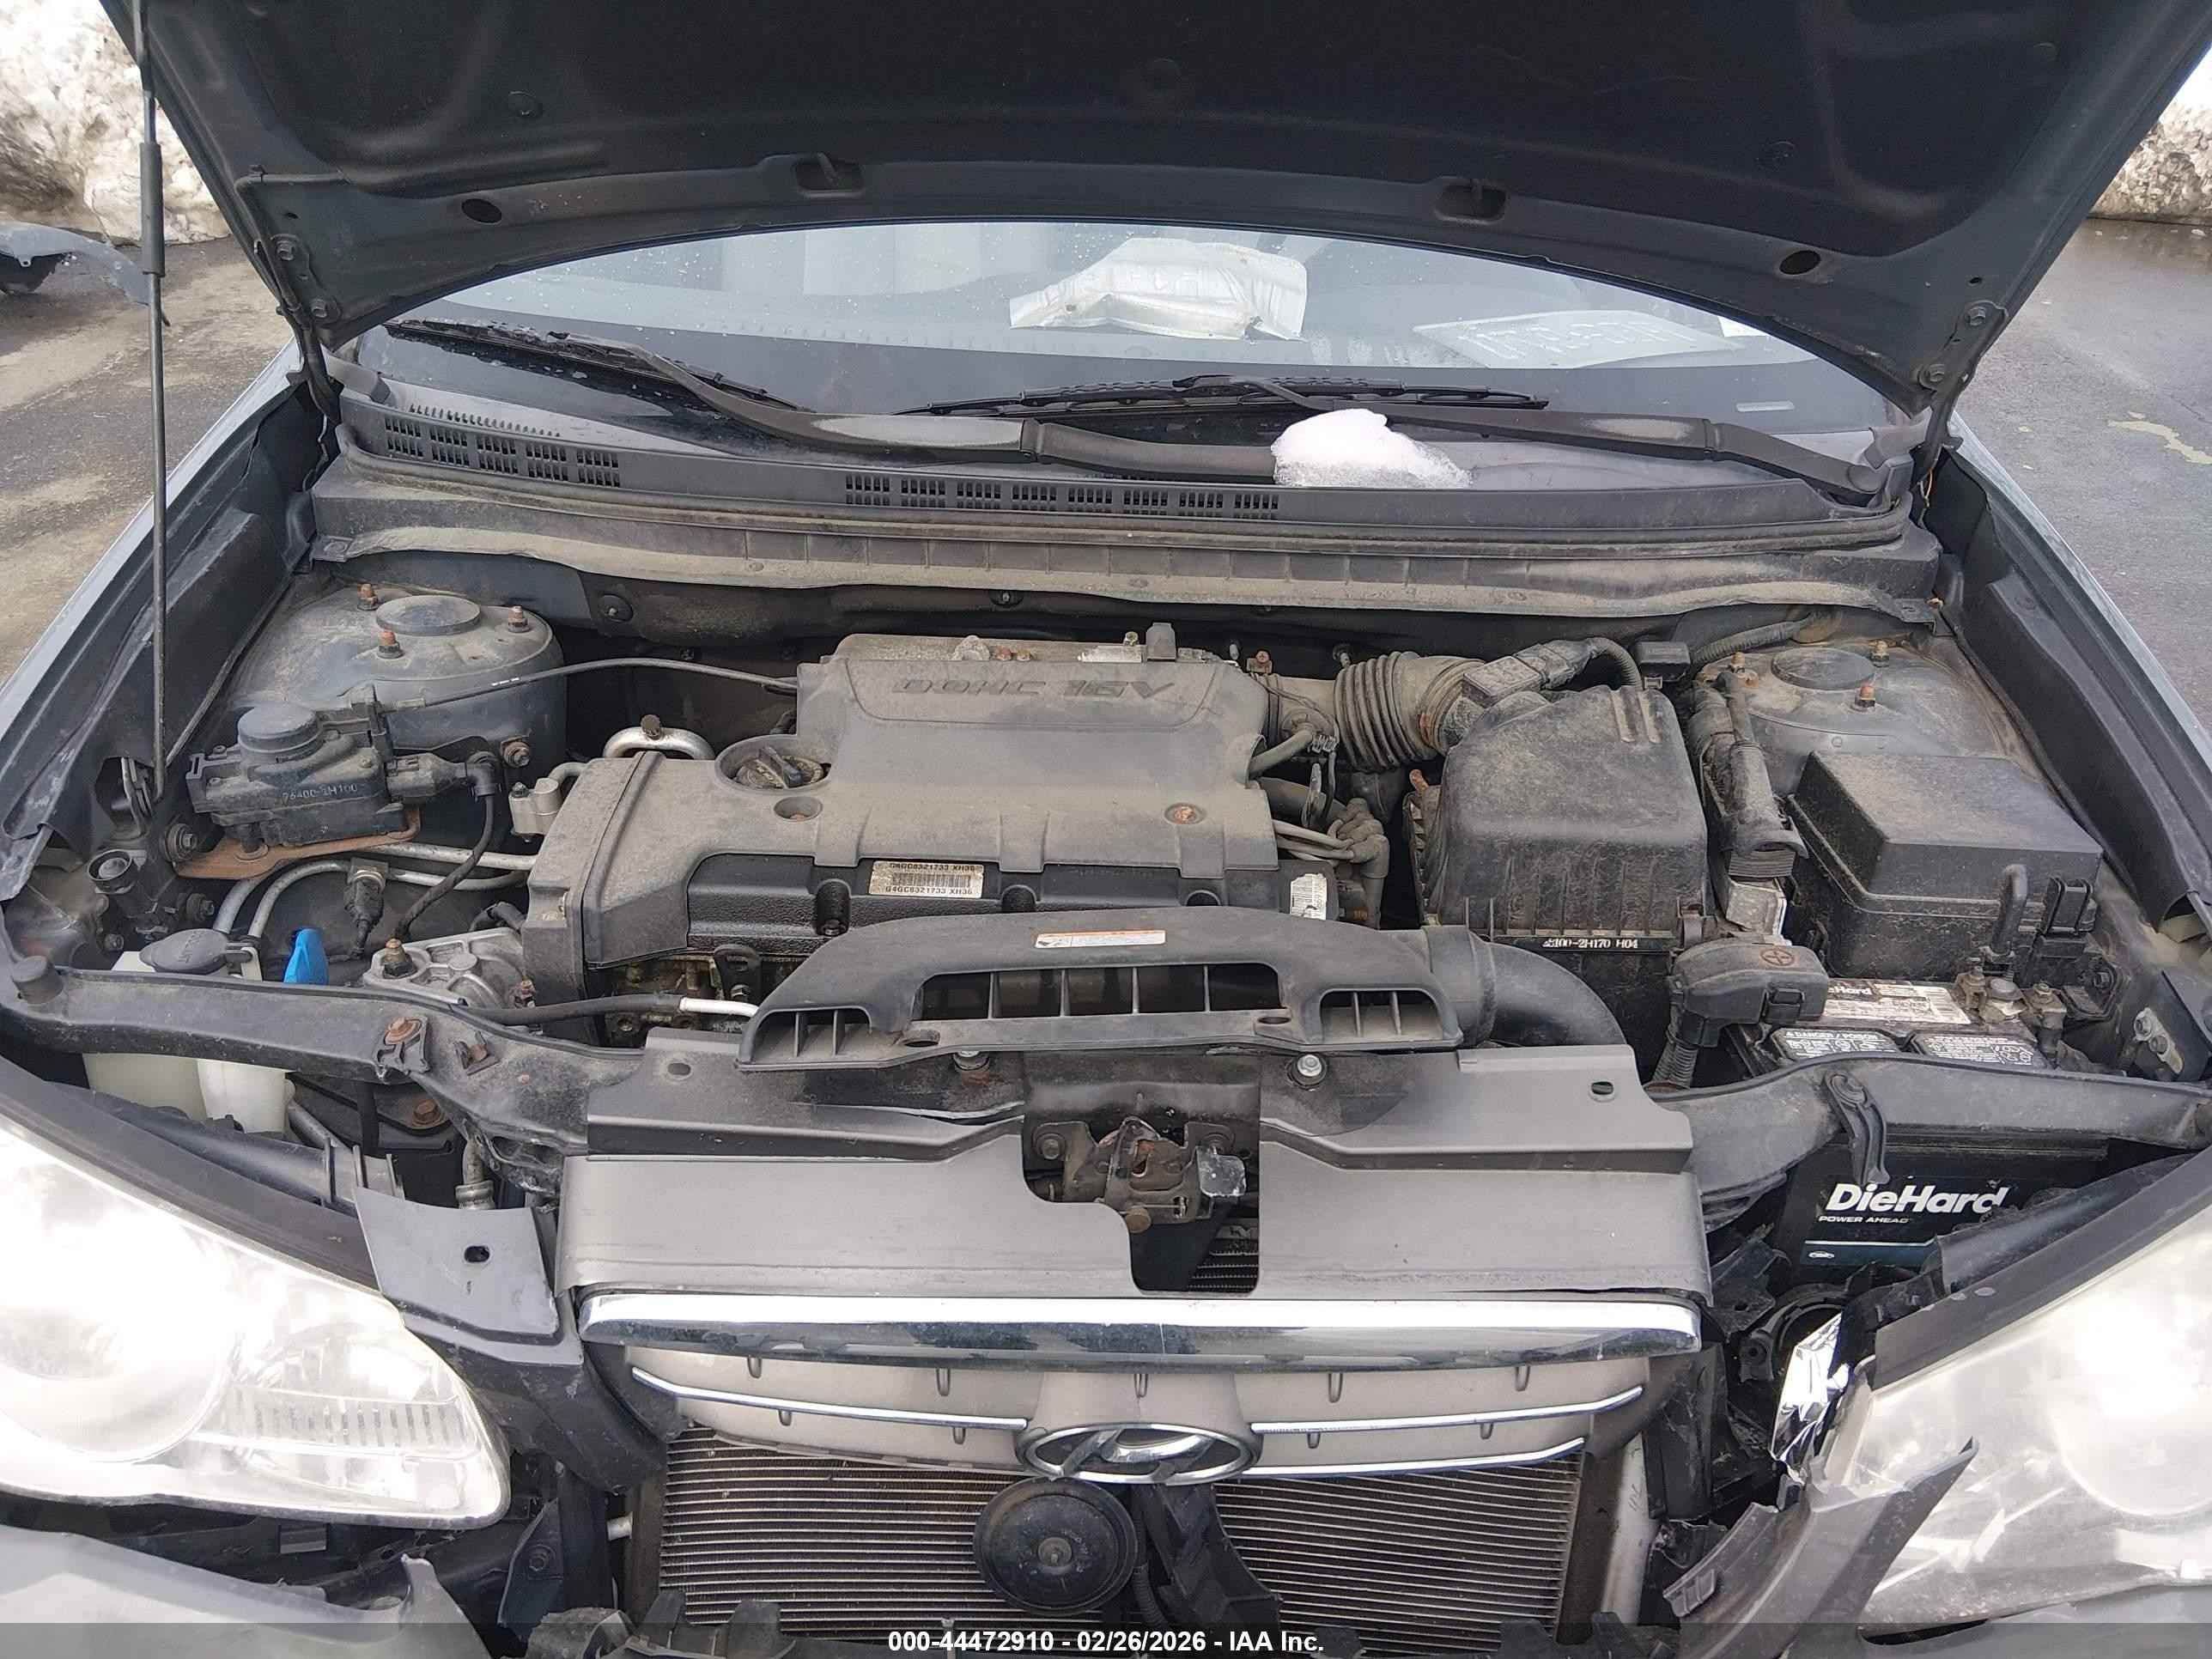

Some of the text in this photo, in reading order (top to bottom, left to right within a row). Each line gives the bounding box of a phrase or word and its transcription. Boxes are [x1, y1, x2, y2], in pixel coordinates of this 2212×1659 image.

[892, 679, 1176, 698] DOHC 16V
[1616, 939, 1638, 949] H04
[1826, 1182, 2009, 1214] DieHard
